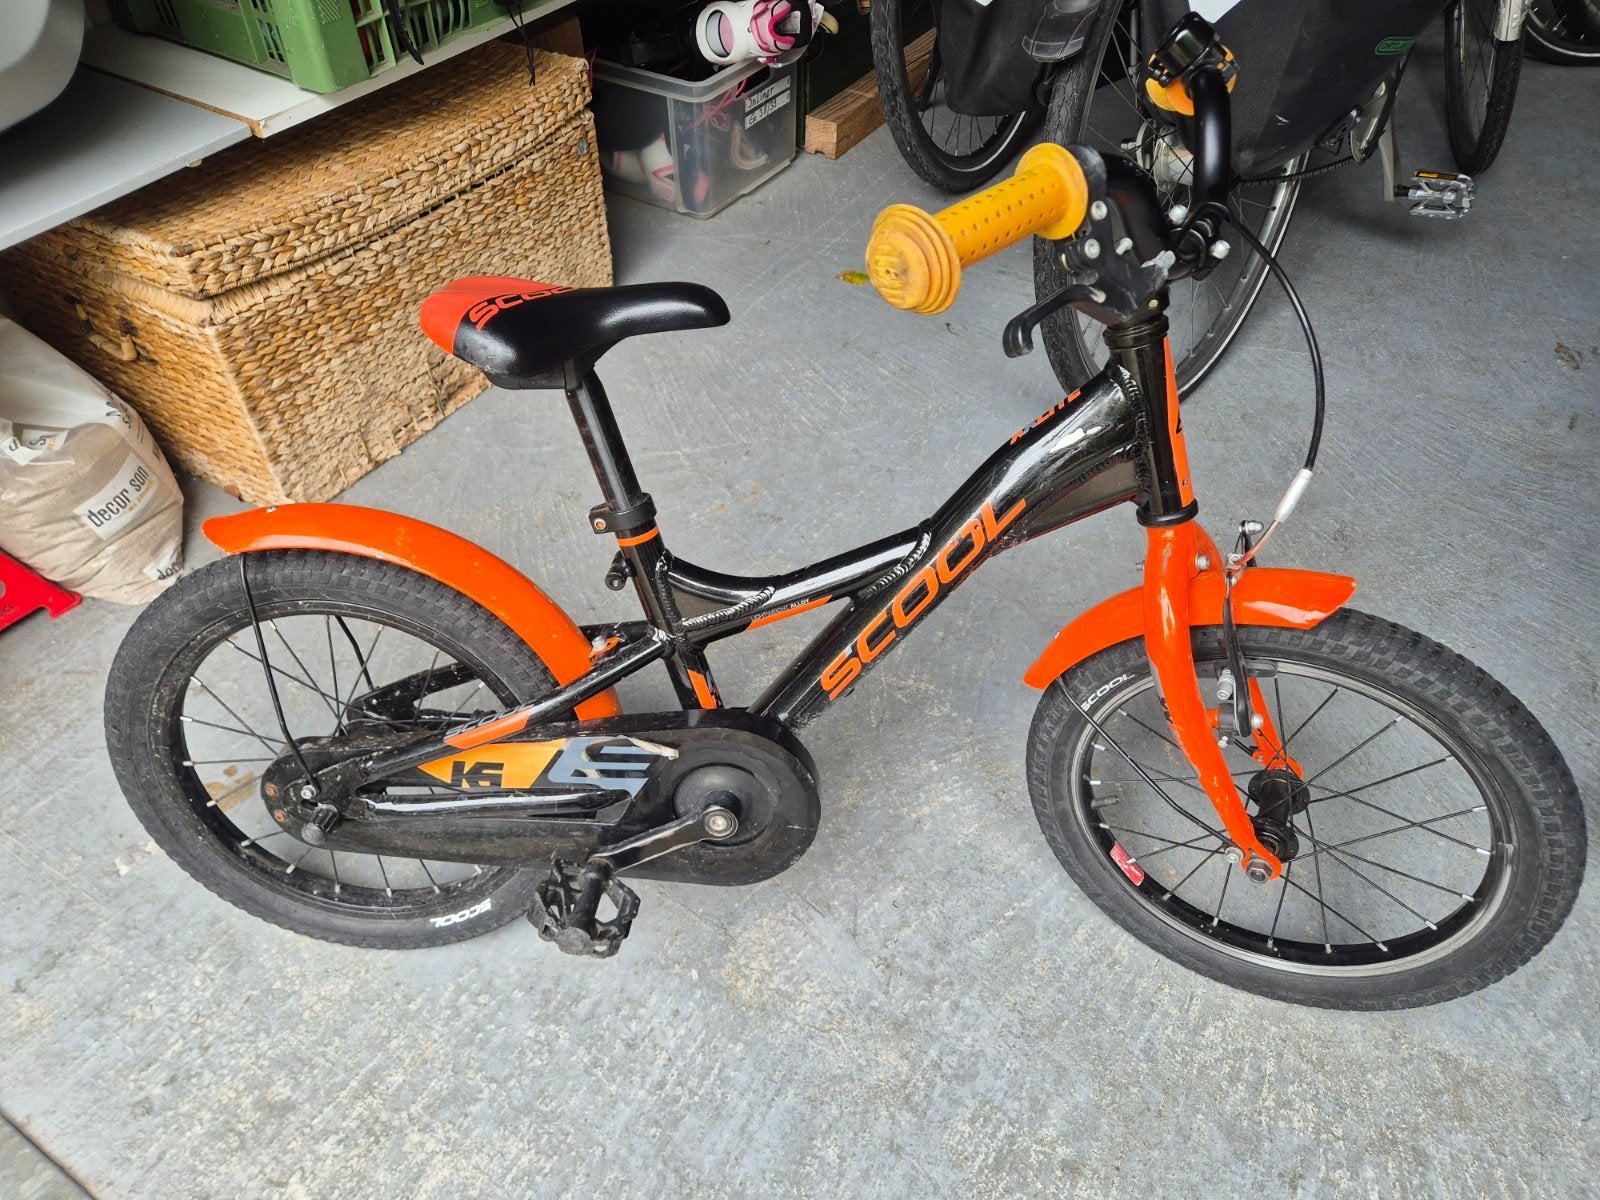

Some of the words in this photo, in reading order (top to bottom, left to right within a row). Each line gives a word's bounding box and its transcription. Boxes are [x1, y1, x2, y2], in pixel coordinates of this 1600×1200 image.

[86, 487, 131, 528] decor
[129, 465, 150, 493] son
[789, 597, 811, 611] ALLOY
[820, 498, 1027, 701] SCOOL
[1081, 673, 1135, 713] SCOOL
[443, 701, 535, 741] SCOOL
[429, 897, 491, 928] SCOOL
